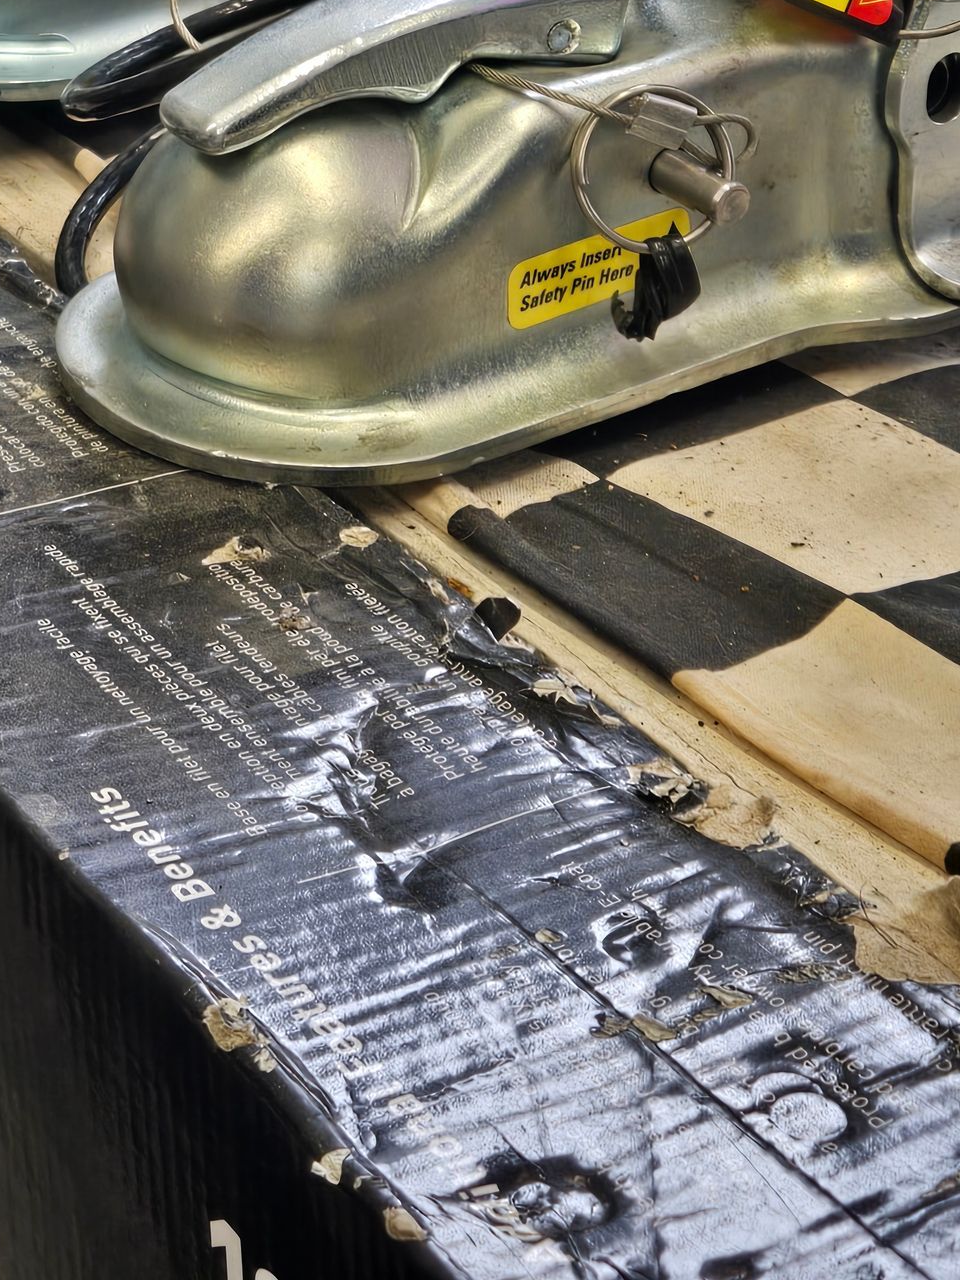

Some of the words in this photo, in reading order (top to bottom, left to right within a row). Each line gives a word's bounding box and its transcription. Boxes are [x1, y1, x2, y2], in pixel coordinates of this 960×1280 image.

[520, 257, 576, 290] Always
[520, 285, 567, 312] Safety
[570, 274, 595, 295] Pin
[599, 264, 634, 286] Here
[39, 356, 57, 368] de
[2, 388, 19, 399] un
[17, 398, 40, 414] con
[38, 397, 56, 408] en
[36, 415, 90, 458] Protegido
[52, 408, 99, 440] pintura
[2, 435, 46, 468] colocar
[90, 440, 109, 452] de
[44, 544, 85, 577] rapide
[230, 560, 282, 600] carbure
[71, 597, 112, 629] fixent
[80, 577, 155, 643] assemblage
[344, 582, 390, 615] filetée
[36, 618, 75, 650] facile
[108, 630, 129, 644] se
[216, 623, 278, 673] tendeurs
[370, 624, 434, 667] goupille
[118, 645, 150, 664] qui
[150, 643, 172, 658] un
[205, 640, 239, 664] filet
[306, 649, 341, 668] par
[345, 654, 364, 667] la
[69, 650, 134, 706] nettoyage
[144, 664, 195, 701] pièces
[165, 660, 208, 687] pour
[233, 666, 274, 691] pour
[327, 668, 360, 689] fini
[358, 667, 376, 677] à
[273, 673, 322, 712] câbles
[366, 677, 443, 735] durabilité
[129, 707, 152, 723] un
[184, 702, 222, 731] deux
[199, 688, 267, 747] ensemble
[375, 710, 411, 729] par
[145, 726, 189, 754] pour
[218, 733, 242, 749] en
[396, 730, 465, 780] Protégé
[440, 736, 488, 773] haute
[176, 755, 212, 781] filet
[207, 782, 230, 798] en
[396, 787, 415, 799] à
[226, 801, 268, 837] Base
[86, 786, 214, 902] Benefits
[560, 861, 622, 907] E-coat
[196, 904, 244, 930] &
[803, 931, 842, 954] pin
[230, 933, 387, 1079] Features
[784, 1046, 893, 1129] Protected
